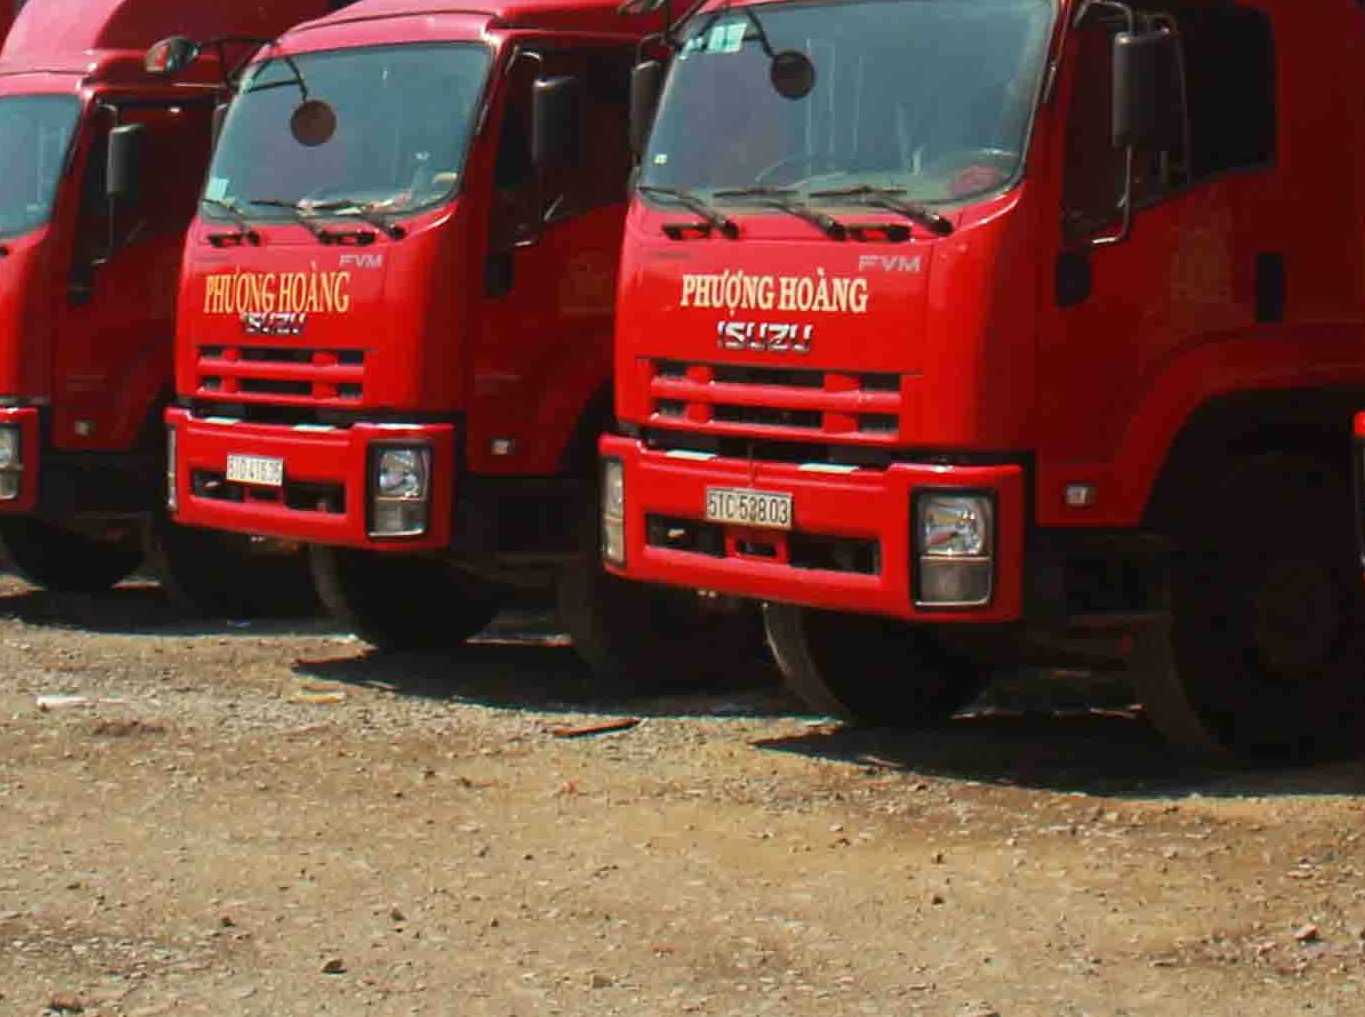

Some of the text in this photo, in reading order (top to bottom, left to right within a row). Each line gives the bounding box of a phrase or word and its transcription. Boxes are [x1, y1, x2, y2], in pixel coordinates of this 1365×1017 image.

[858, 254, 924, 272] FVM
[277, 259, 351, 313] HOÀNG
[681, 266, 870, 317] PHƯỢNG HOÀNG
[717, 320, 814, 353] ISUZU
